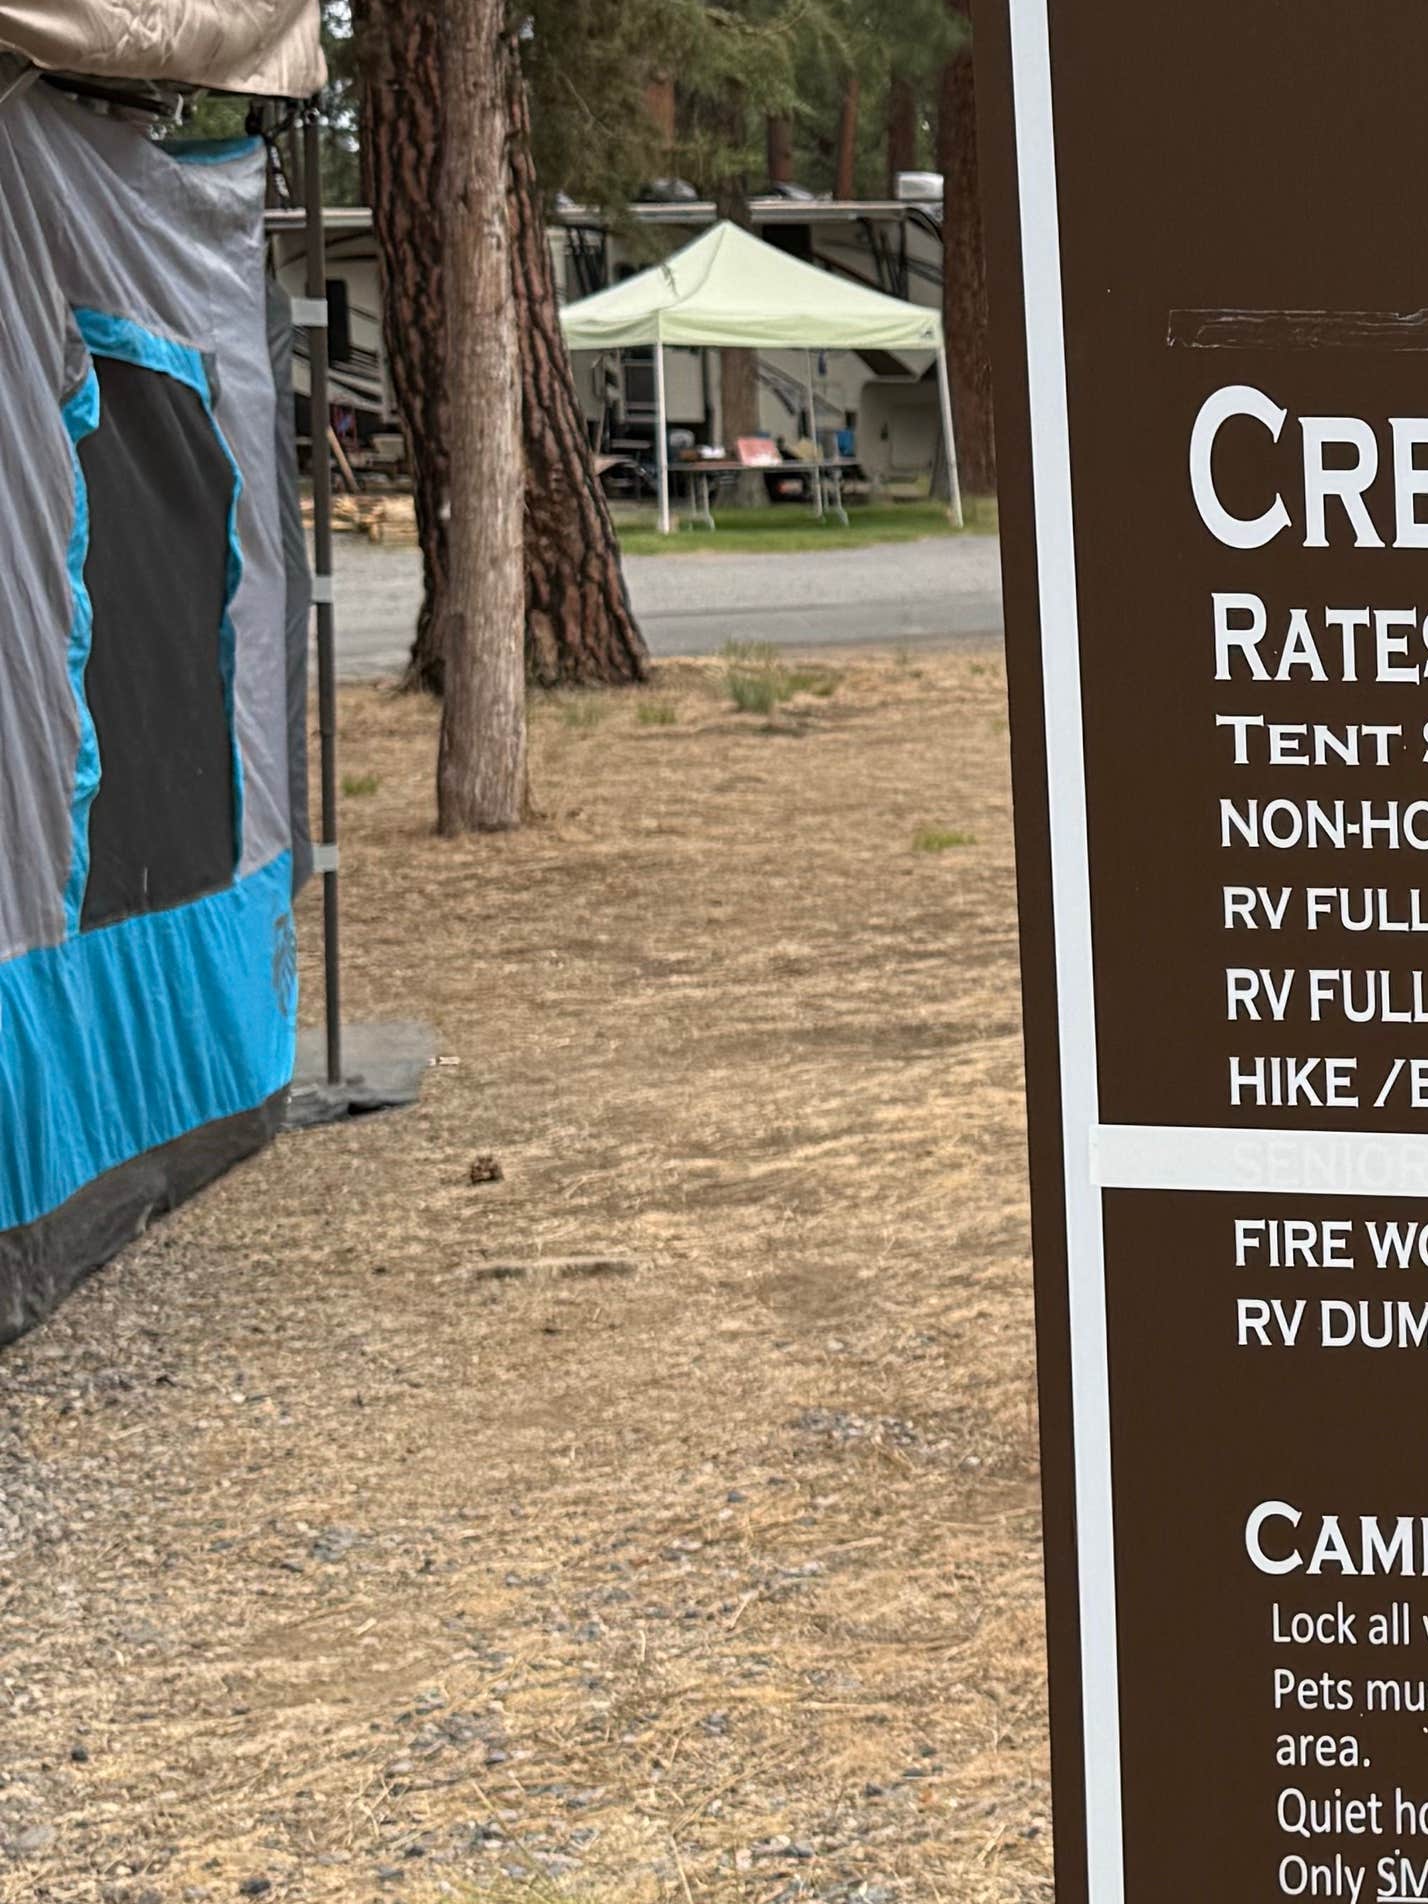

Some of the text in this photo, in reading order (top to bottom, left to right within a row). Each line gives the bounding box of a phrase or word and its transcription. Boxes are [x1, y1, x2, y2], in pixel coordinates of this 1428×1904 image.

[1224, 887, 1292, 929] RV
[1226, 969, 1294, 1020] RV
[1229, 1057, 1358, 1107] HIKE
[1235, 1220, 1353, 1268] FIRE
[1237, 1299, 1306, 1345] RV
[1273, 1602, 1356, 1644] Lock
[1369, 1603, 1409, 1644] all
[1275, 1669, 1353, 1710] Pets
[1277, 1735, 1370, 1767] area.
[1278, 1788, 1382, 1837] Quiet
